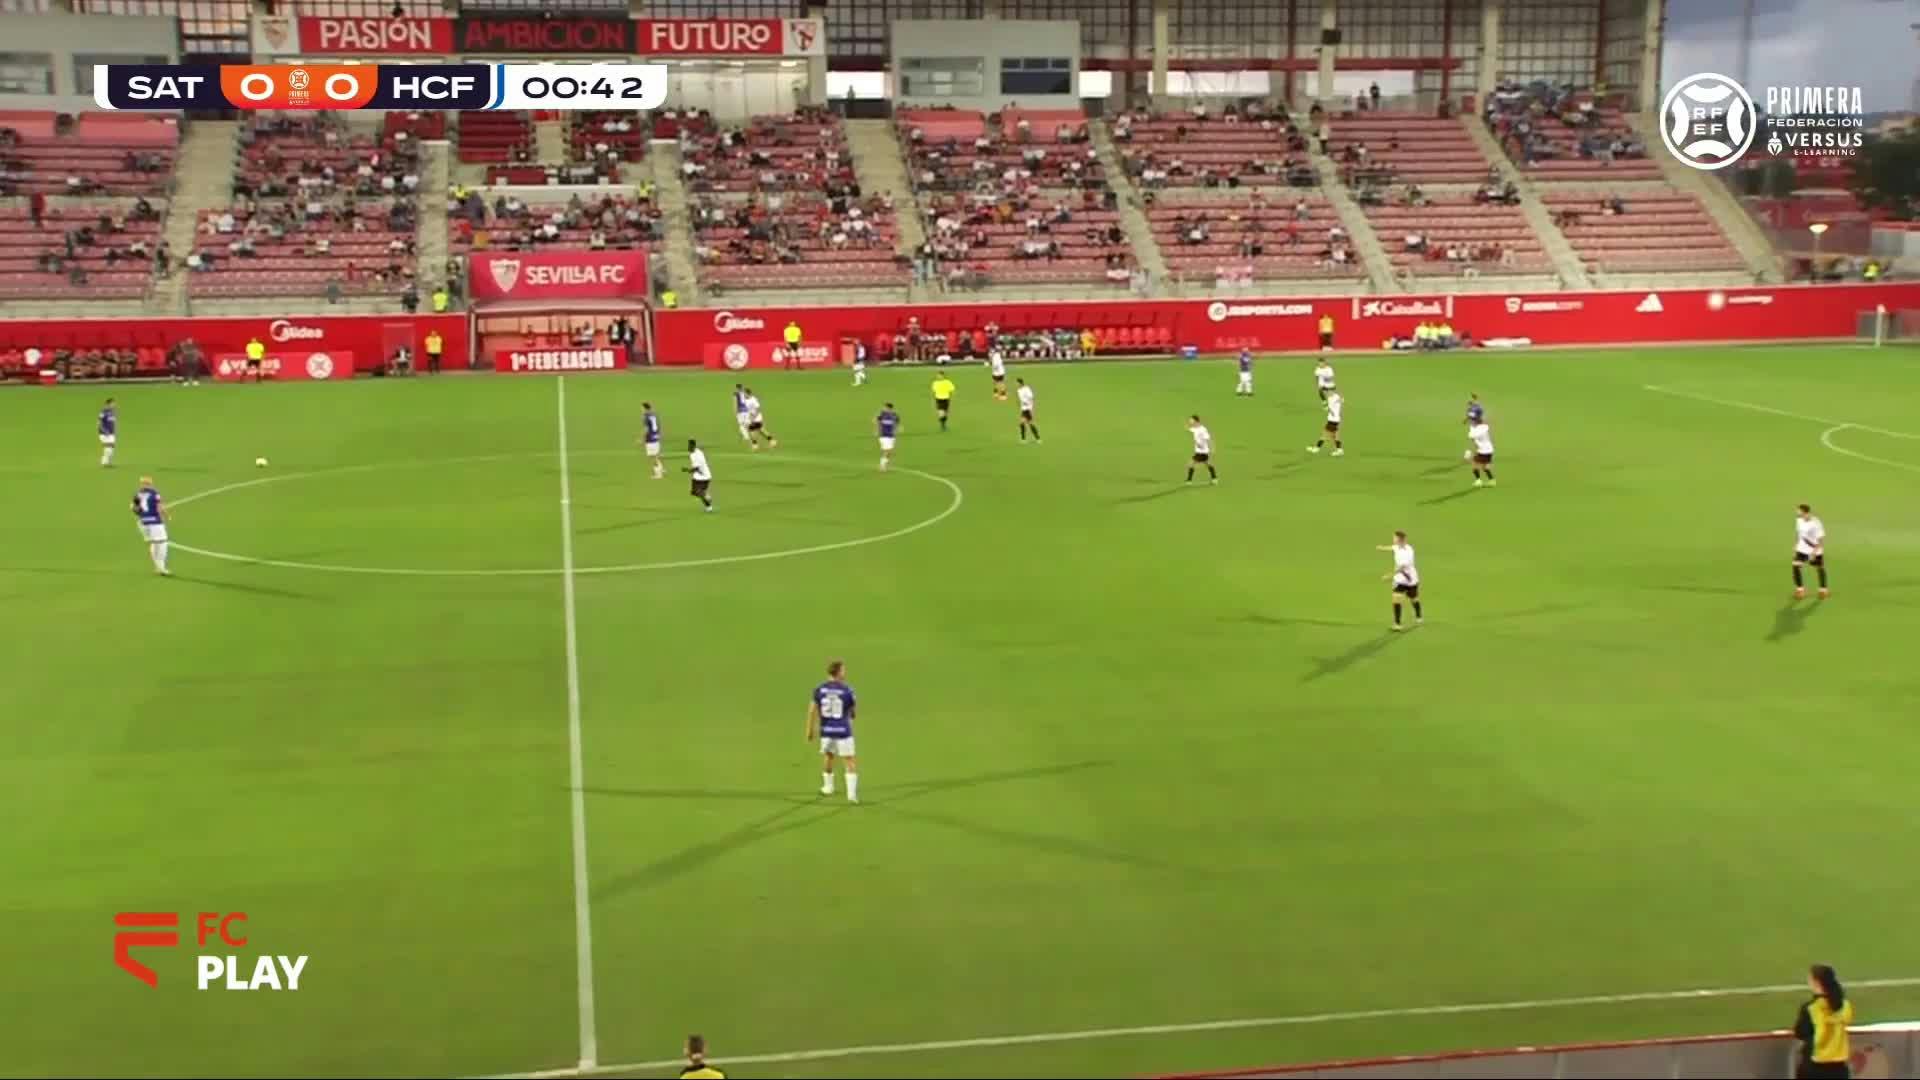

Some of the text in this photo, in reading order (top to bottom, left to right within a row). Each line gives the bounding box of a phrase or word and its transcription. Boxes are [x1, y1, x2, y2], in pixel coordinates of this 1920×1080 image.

[319, 18, 431, 49] PASIÓN
[465, 18, 625, 49] AMBICIÓN
[651, 22, 770, 50] FUTURO
[525, 265, 625, 285] SEVILLA FC
[527, 349, 615, 370] FEDERACIÓN
